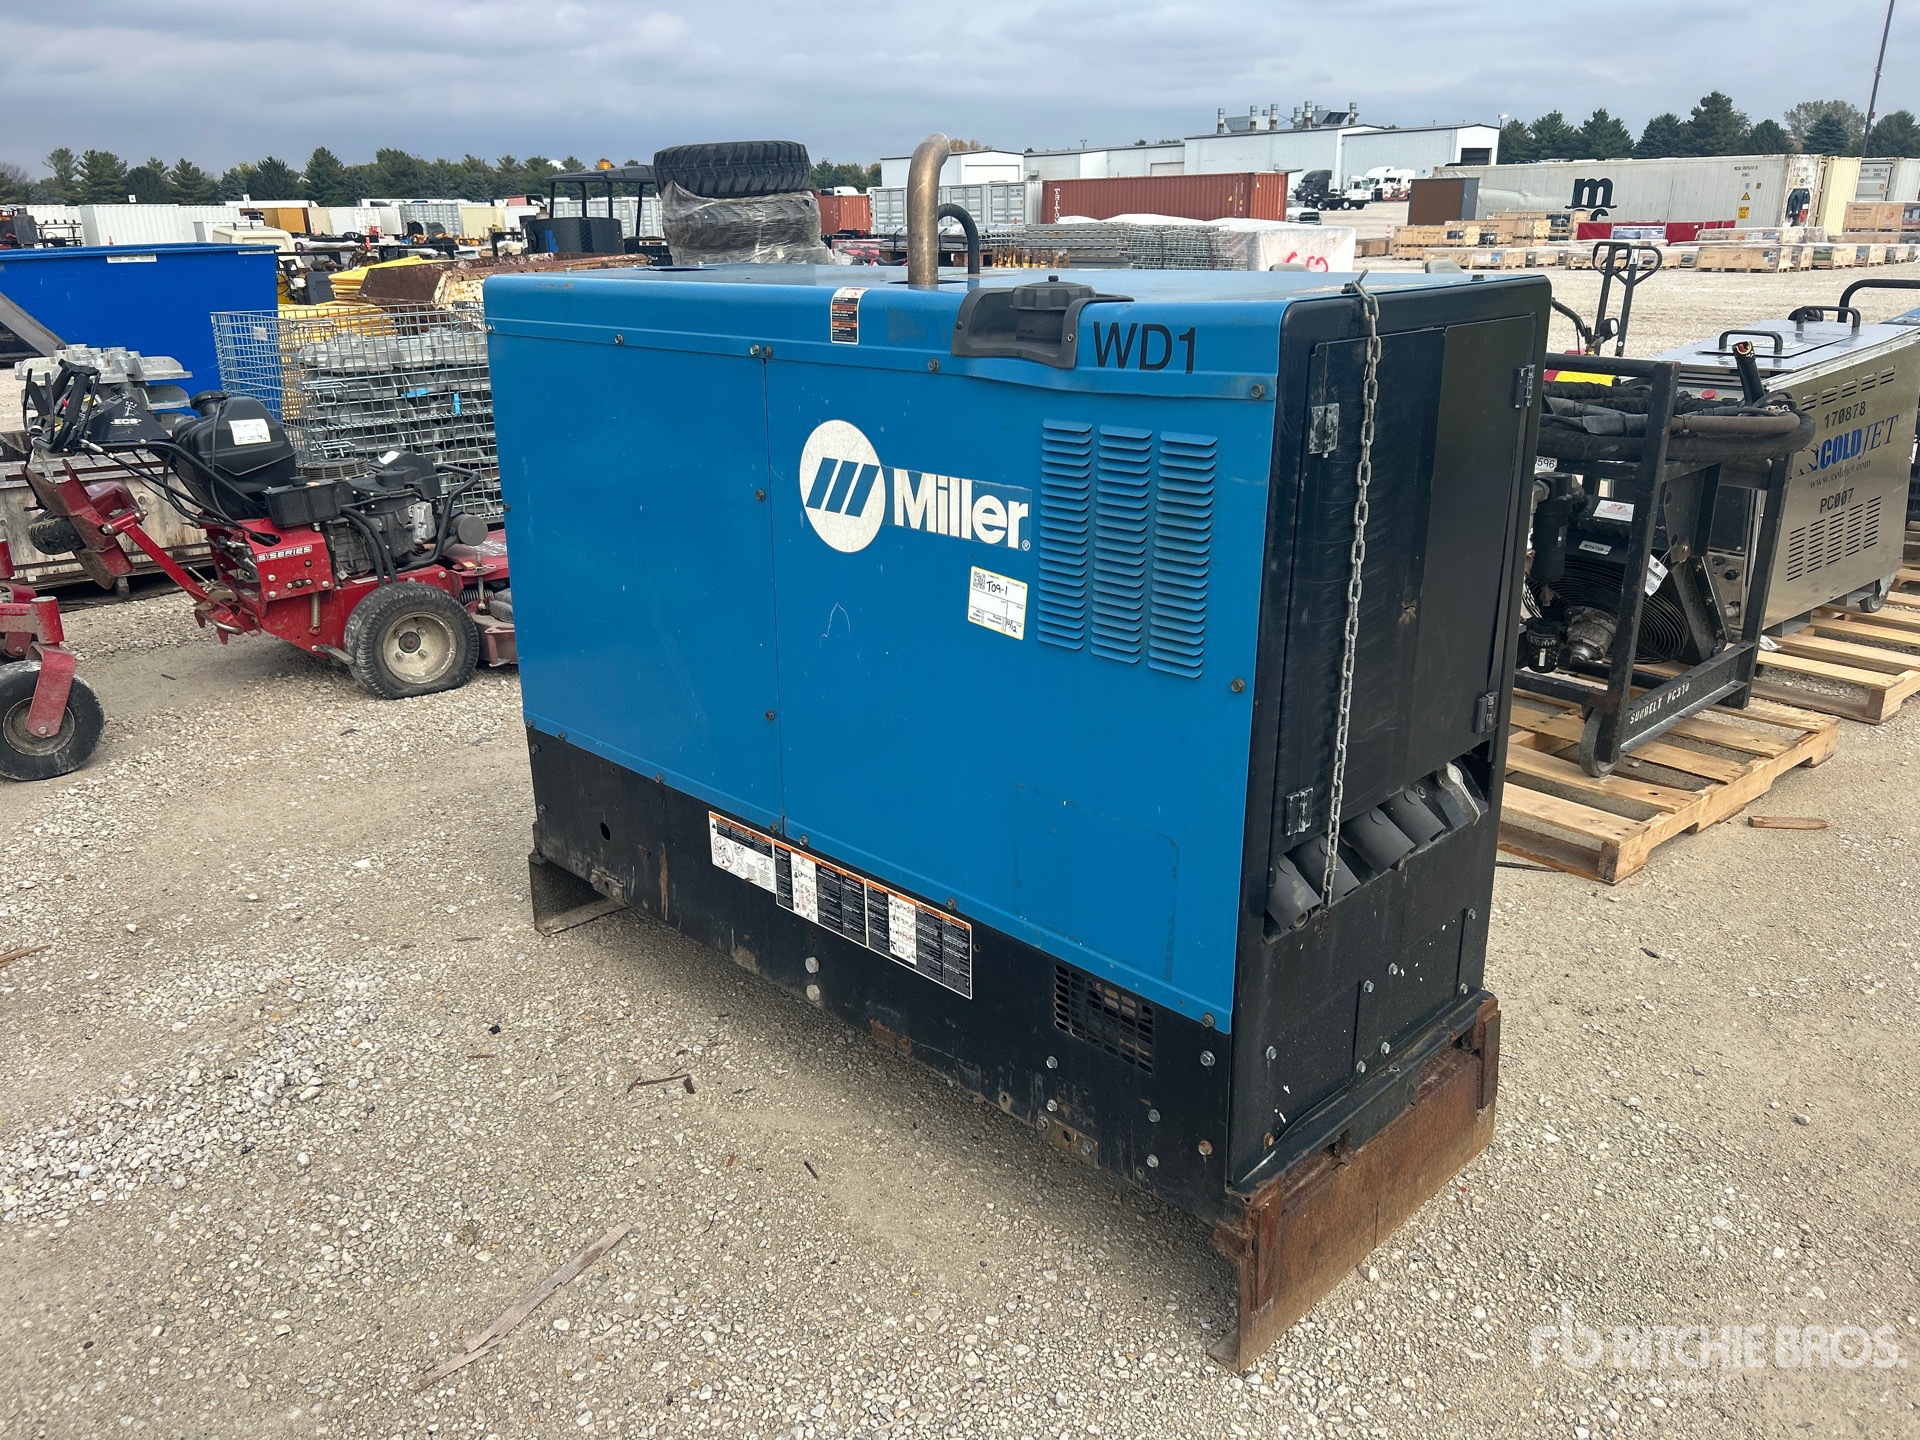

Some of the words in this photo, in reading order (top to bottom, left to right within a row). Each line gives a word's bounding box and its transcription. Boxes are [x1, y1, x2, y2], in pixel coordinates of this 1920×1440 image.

[1093, 321, 1196, 374] WD1
[1824, 401, 1866, 429] 170878
[1809, 460, 1872, 489] www.coldjet.com
[893, 468, 1029, 549] Miller
[1819, 487, 1855, 514] PC007
